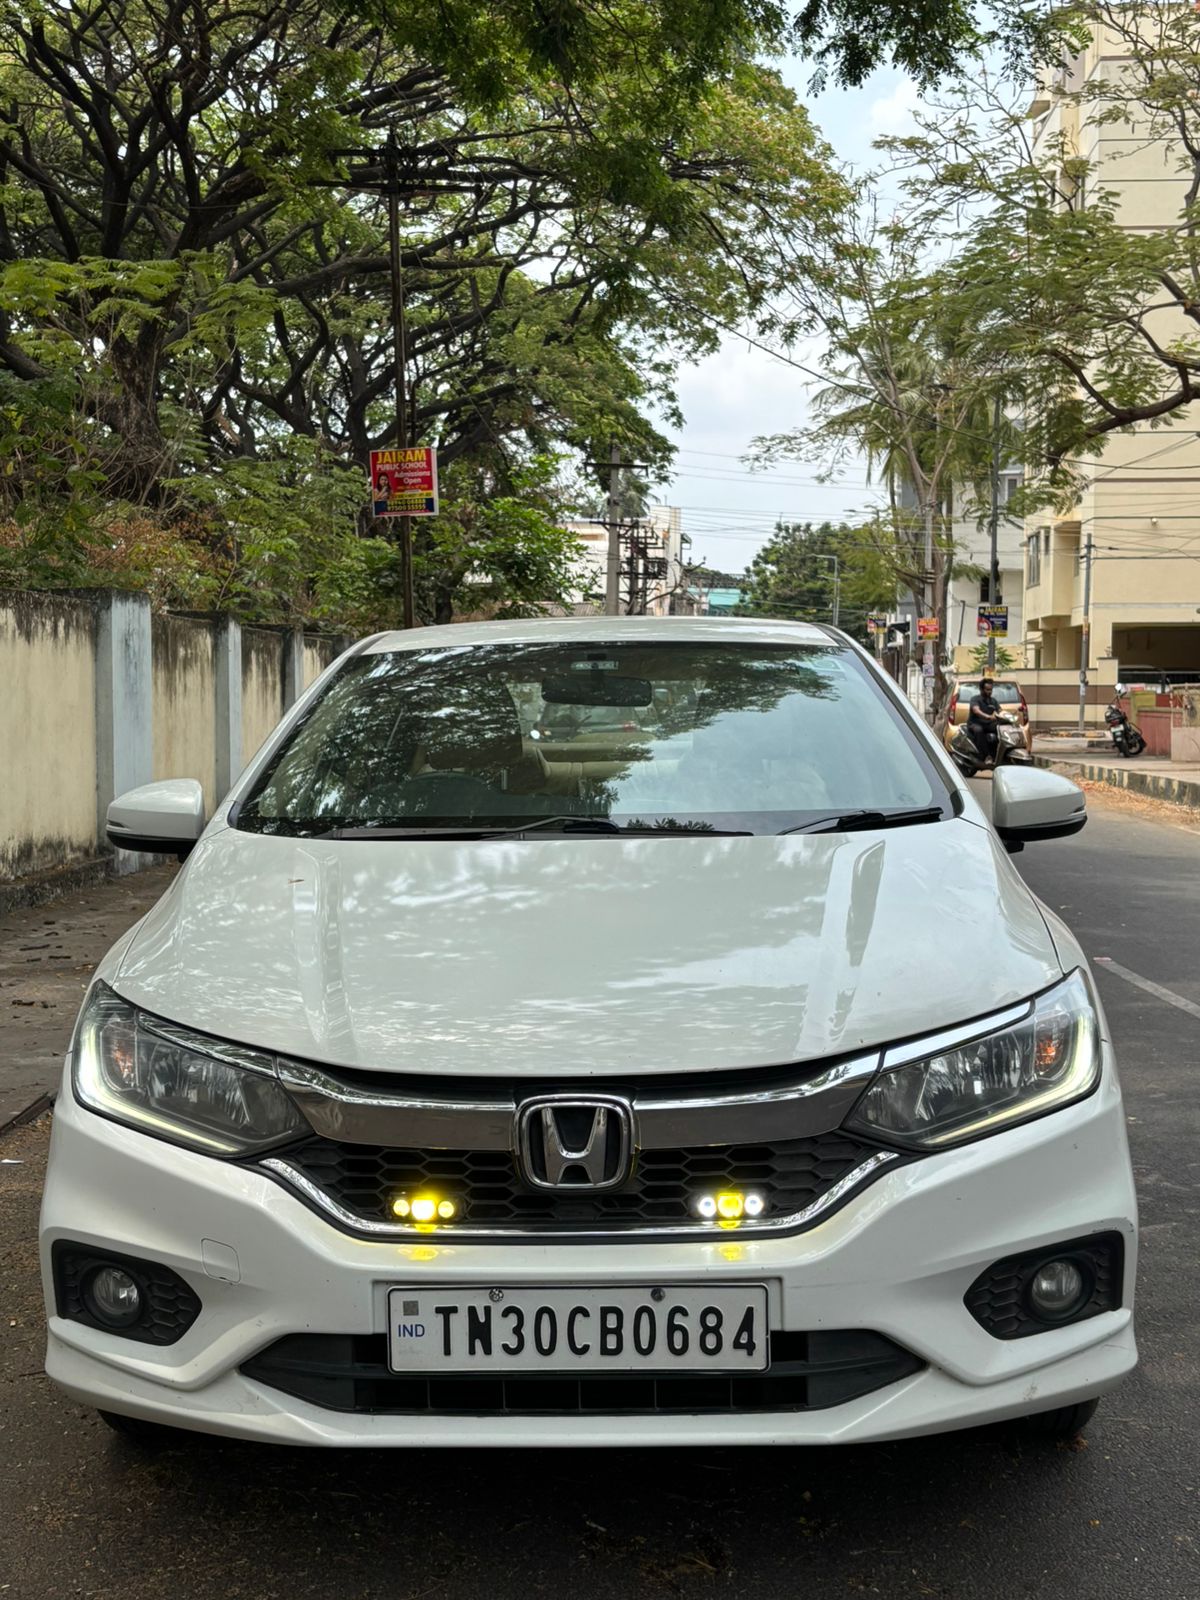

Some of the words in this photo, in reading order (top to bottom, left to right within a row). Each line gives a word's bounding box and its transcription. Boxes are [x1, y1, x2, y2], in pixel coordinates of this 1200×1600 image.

[377, 450, 426, 463] JAIRAM
[376, 463, 400, 471] PUBLIC
[398, 1324, 425, 1338] IND
[434, 1305, 756, 1357] TN30CB0684
